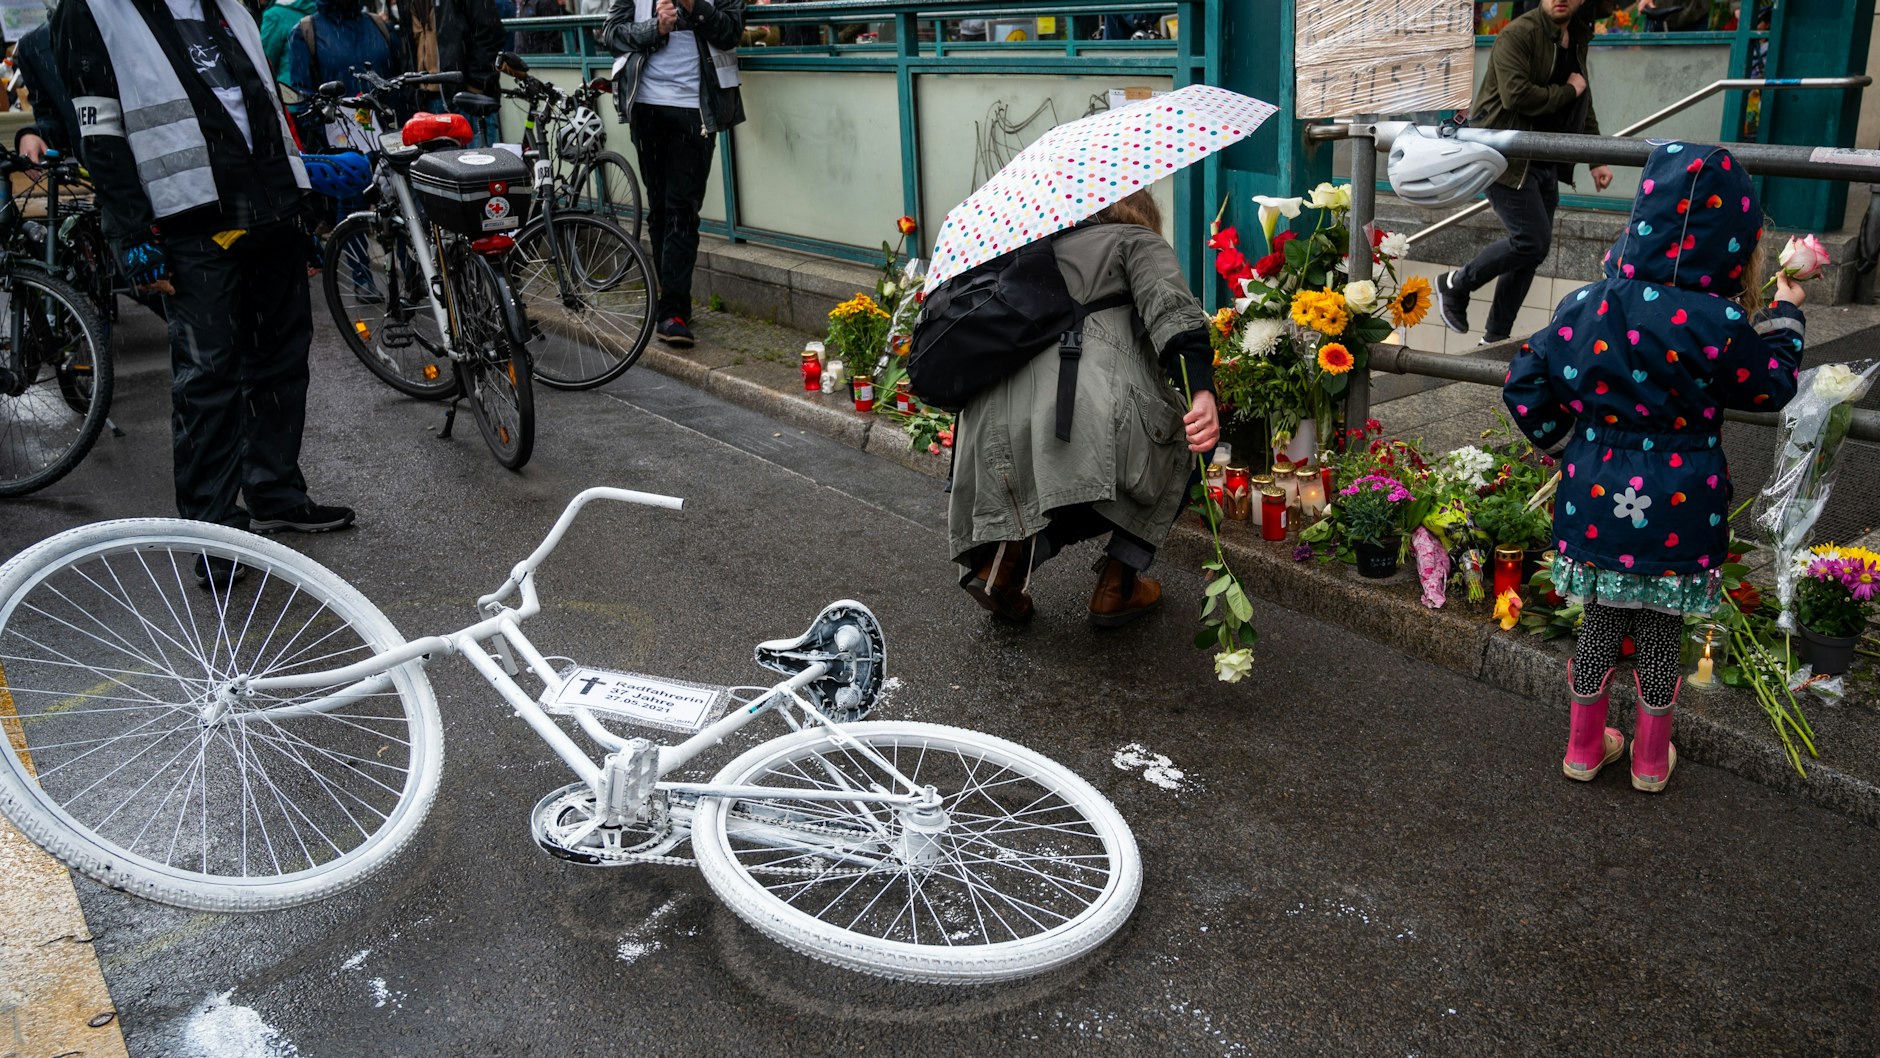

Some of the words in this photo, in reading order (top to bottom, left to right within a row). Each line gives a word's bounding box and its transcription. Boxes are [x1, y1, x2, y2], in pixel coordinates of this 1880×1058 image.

[610, 686, 630, 695] 37
[632, 693, 674, 707] Jahre
[615, 681, 703, 704] Radfahrerin
[605, 694, 670, 713] 27.05.2021
